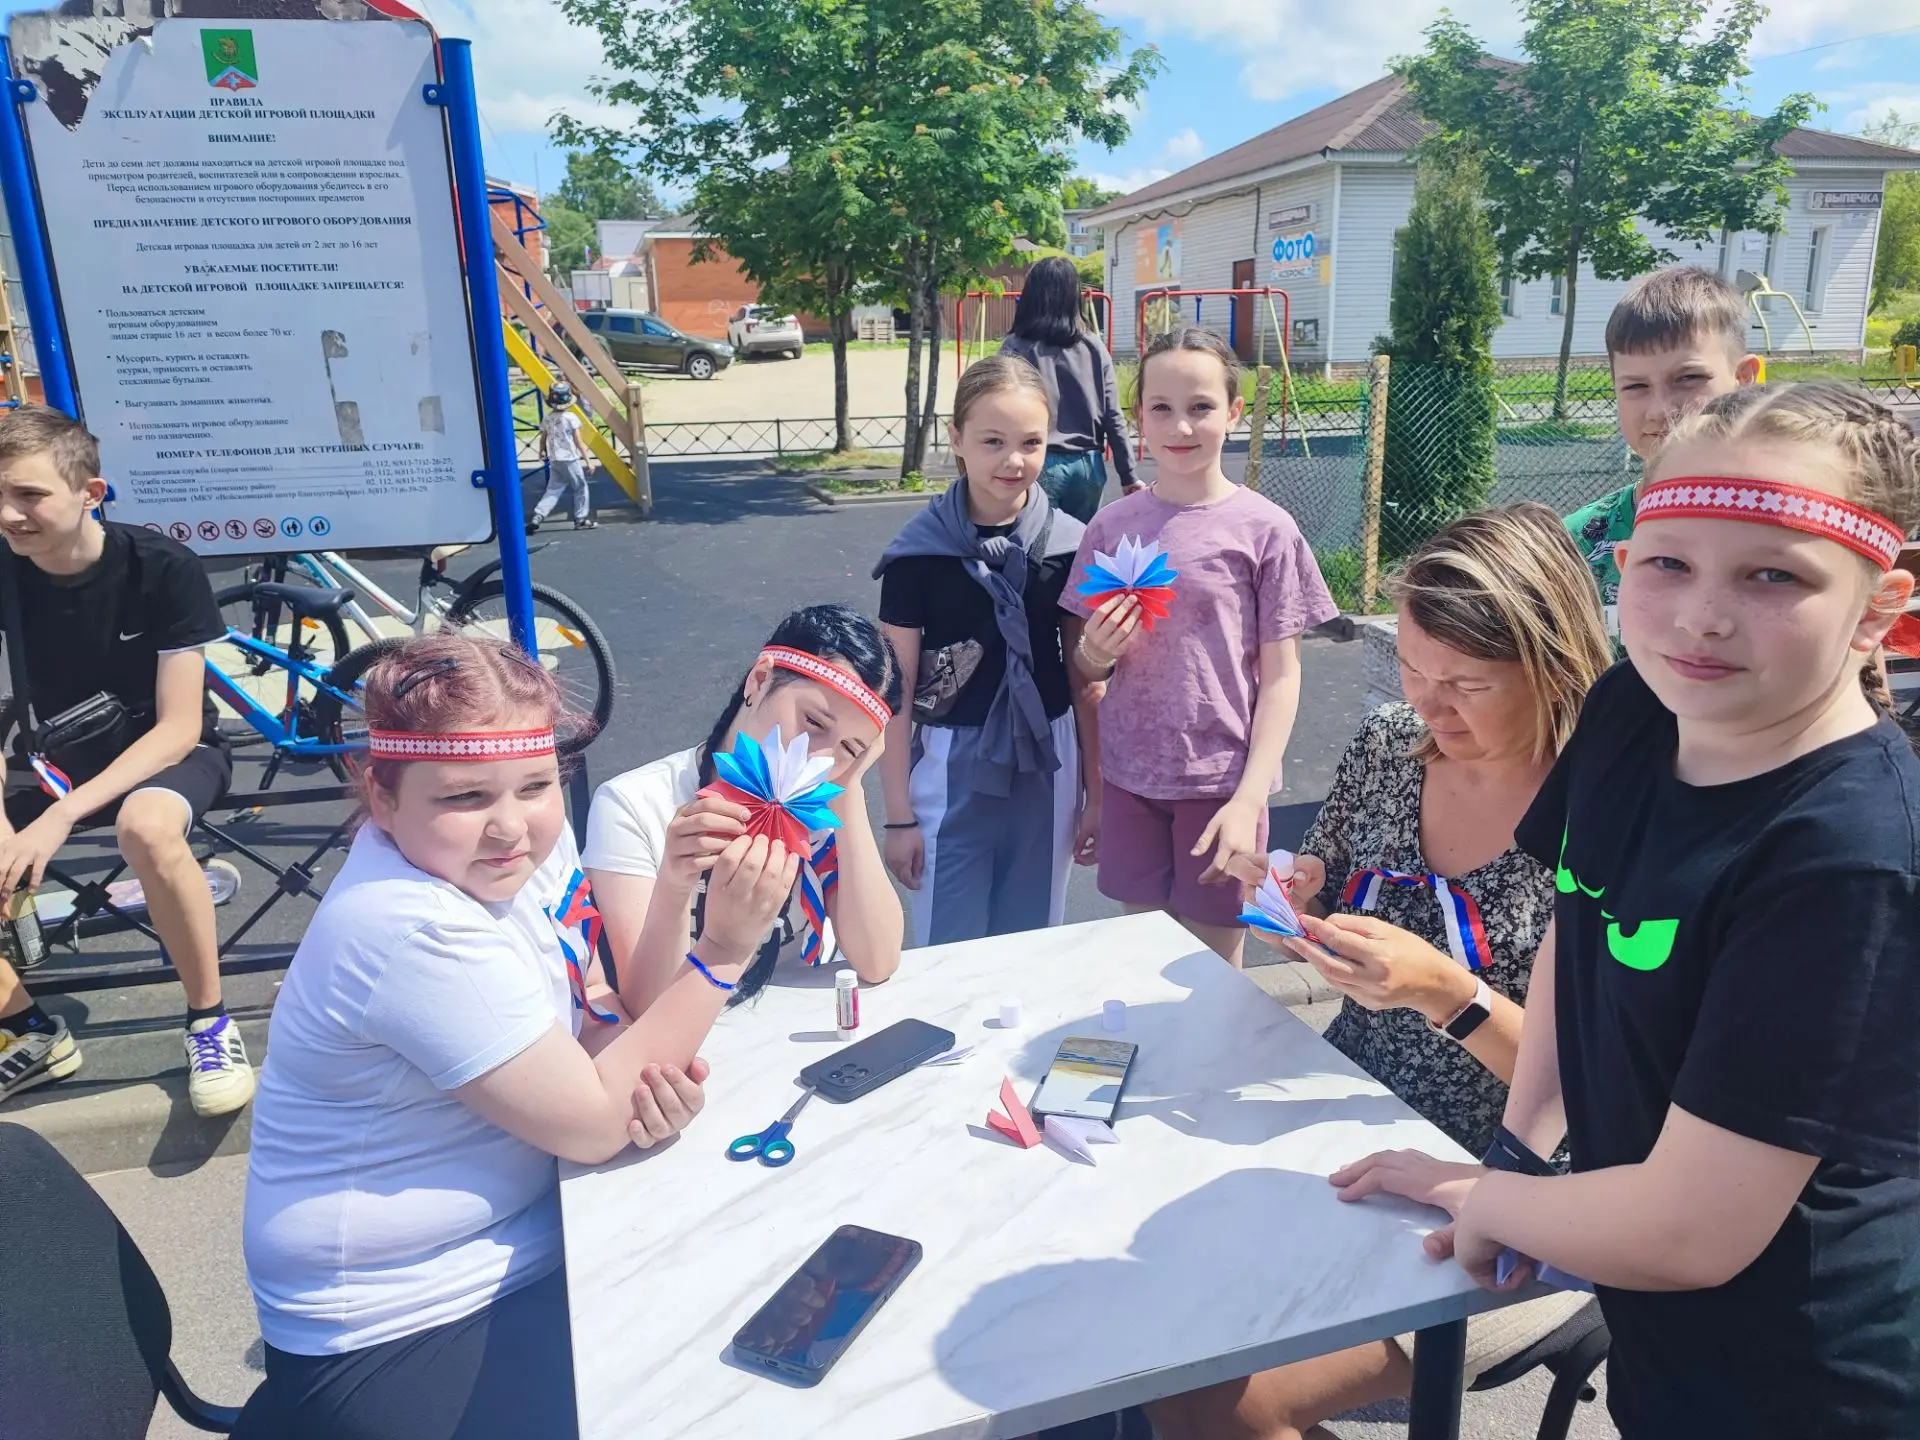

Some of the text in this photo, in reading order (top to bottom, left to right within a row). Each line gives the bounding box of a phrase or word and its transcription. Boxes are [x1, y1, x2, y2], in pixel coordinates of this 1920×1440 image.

[211, 98, 263, 106] ПРАВИЛА
[101, 109, 376, 120] ЭКСПЛУАТАЦИИ ДЕТСКОЙ ИГРОВОЙ ПЛОЩАДКИ
[208, 134, 276, 142] ВНИМАНИЕ!
[82, 160, 105, 168] Дети
[163, 160, 198, 168] должны
[202, 160, 252, 168] находиться
[268, 159, 302, 168] детской
[305, 159, 340, 168] игровой
[343, 160, 386, 168] площадке
[388, 160, 404, 168] под
[88, 173, 144, 182] присмотром
[147, 171, 196, 182] родителей,
[198, 171, 258, 179] воспитателей
[287, 172, 356, 180] сопровождении
[106, 184, 135, 193] Перед
[213, 184, 253, 192] игрового
[256, 183, 318, 192] оборудования
[320, 183, 365, 192] убедитесь
[135, 195, 196, 204] безопасности
[206, 196, 256, 204] отсутствии
[258, 196, 316, 204] посторонних
[1825, 193, 1879, 203] ВЫПЕЧКА
[94, 216, 412, 229] ПРЕДНАЗНАЧЕНИЕ ДЕТСКОГО ИГРОВОГО ОБОРУДОВАНИЯ
[136, 243, 172, 252] Детская
[174, 244, 208, 252] игровая
[212, 242, 255, 250] площадка
[258, 242, 272, 250] для
[276, 241, 300, 249] детей
[339, 242, 349, 250] до
[352, 240, 362, 248] 16
[1273, 233, 1314, 261] ФОТО
[184, 263, 338, 274] УВАЖАЕМЫЕ ПОСЕТИТЕЛИ!
[122, 281, 404, 294] НА ДЕТСКОЙ ИГРОВОЙ ПЛОЩАДКЕ ЗАПРЕЩАЕТСЯ!
[106, 308, 205, 318] Пользоваться детским
[108, 319, 218, 330] игровым оборудованием
[140, 332, 172, 340] старше
[174, 330, 185, 338] 16
[243, 328, 268, 337] более
[270, 328, 281, 336] 70
[116, 355, 163, 364] Мусорить,
[206, 353, 250, 361] оставлять
[210, 364, 253, 372] оставлять
[119, 375, 213, 386] стеклянные бутылки.
[128, 418, 289, 430] Использовать игровое оборудование
[157, 432, 213, 440] назначению.
[156, 442, 424, 460] НОМЕРА ТЕЛЕФОНОВ ДЛЯ ЭКСТРЕННЫХ СЛУЧАЕВ:
